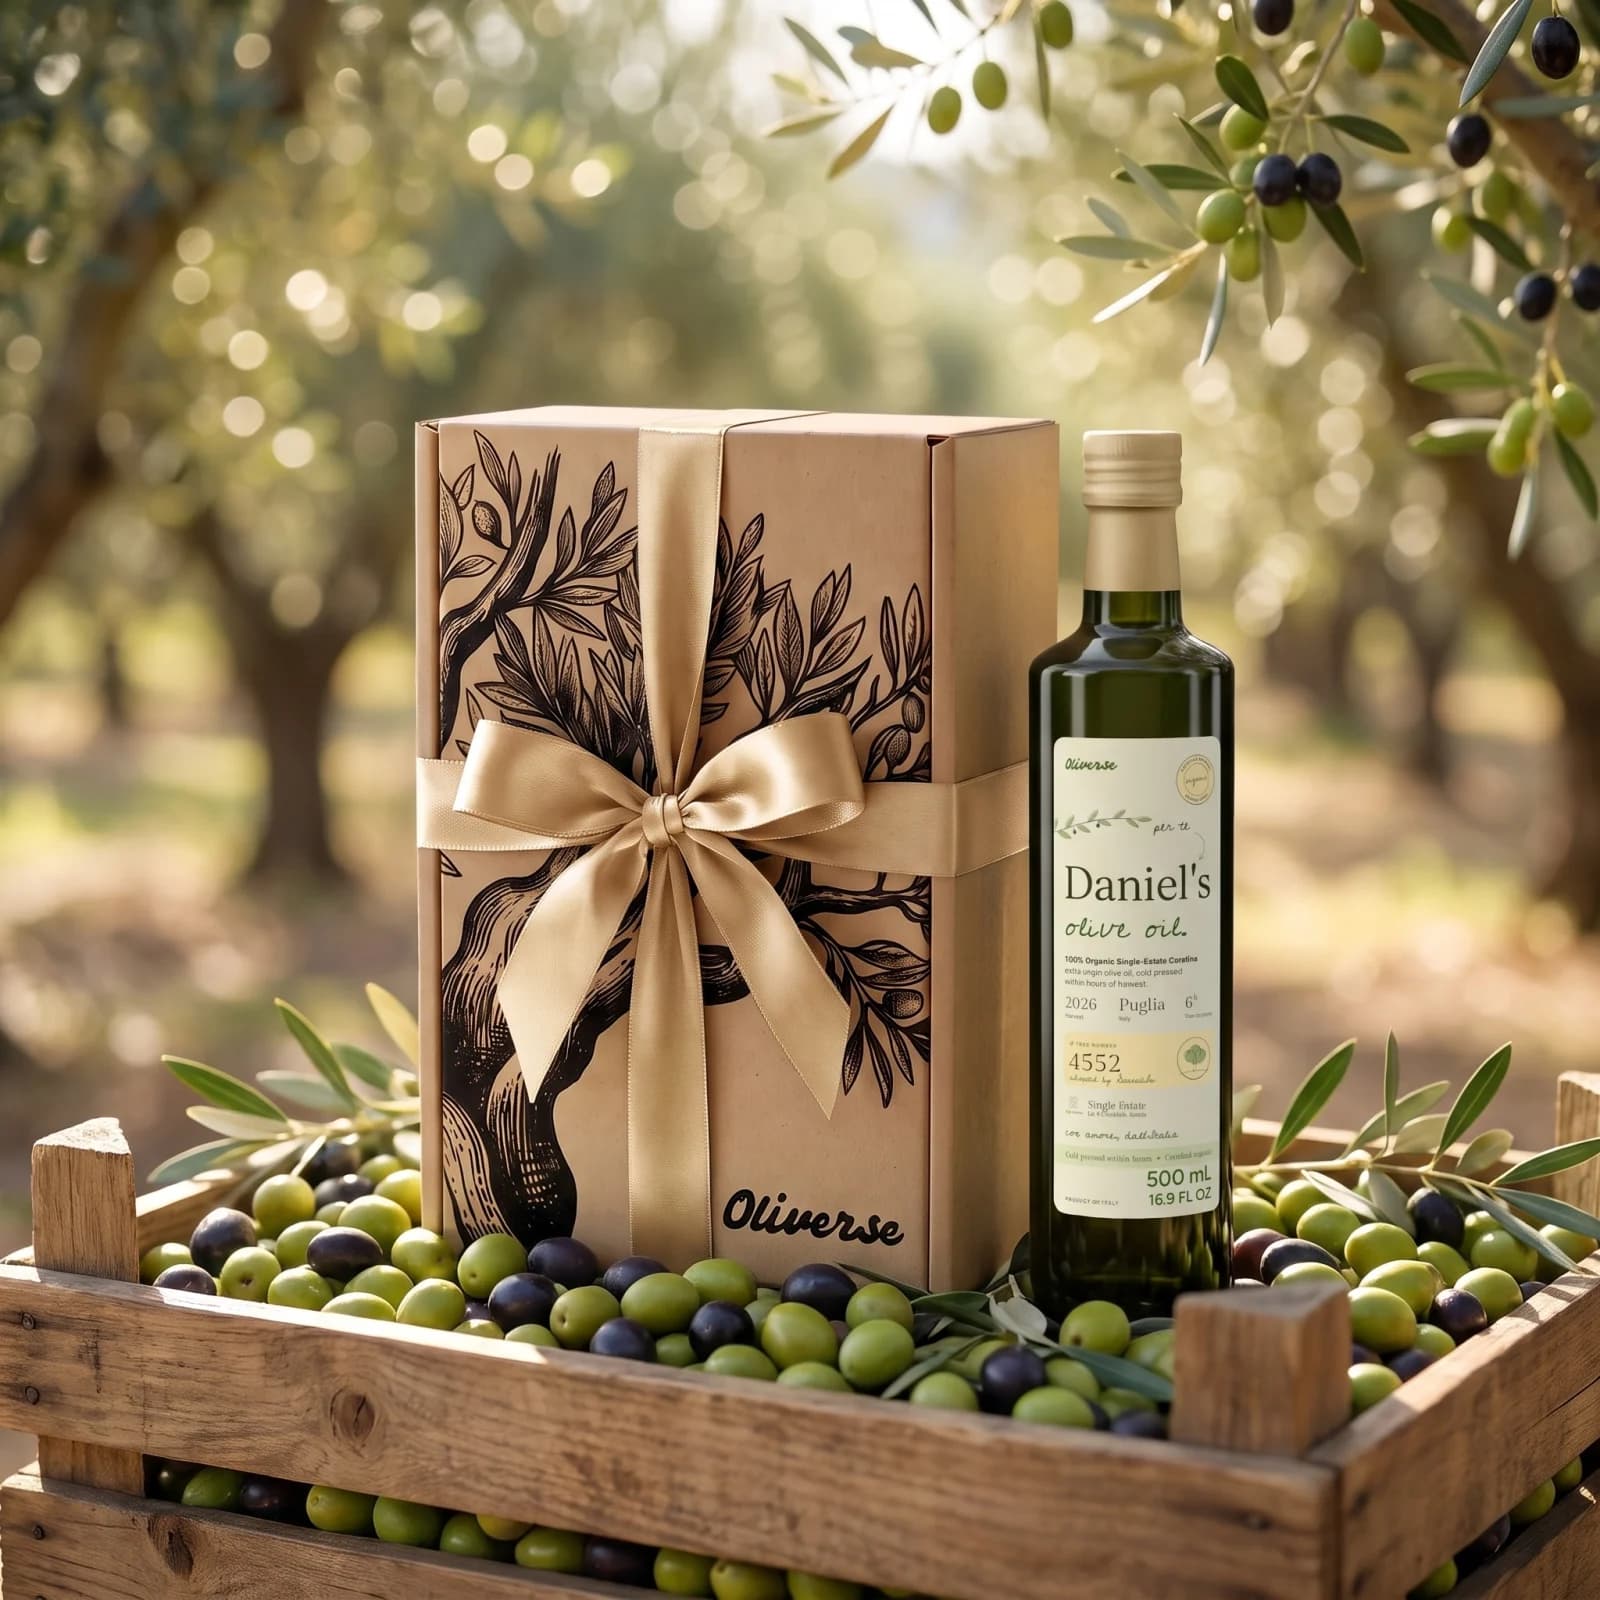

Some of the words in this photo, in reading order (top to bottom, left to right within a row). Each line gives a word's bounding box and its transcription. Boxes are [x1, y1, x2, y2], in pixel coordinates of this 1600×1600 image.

[1153, 821, 1175, 836] per
[1179, 821, 1190, 831] te
[1065, 863, 1211, 901] Daniel's
[1065, 917, 1131, 938] olive
[1145, 916, 1188, 938] oil.
[1065, 955, 1083, 964] 100%
[1085, 957, 1115, 966] Organic
[1116, 956, 1167, 967] Single-Estate
[1153, 968, 1183, 977] pressed
[1086, 980, 1107, 988] hours
[1108, 980, 1116, 988] of
[1065, 996, 1097, 1010] 2026
[1119, 997, 1166, 1016] Puglia
[1068, 1052, 1121, 1073] 4552
[1087, 1100, 1117, 1112] Single
[1147, 1168, 1184, 1187] 500
[1189, 1164, 1212, 1183] mL
[1149, 1193, 1175, 1206] 16.9
[1178, 1191, 1193, 1204] FL
[1195, 1187, 1212, 1201] OZ
[722, 1188, 905, 1247] Oliverse
